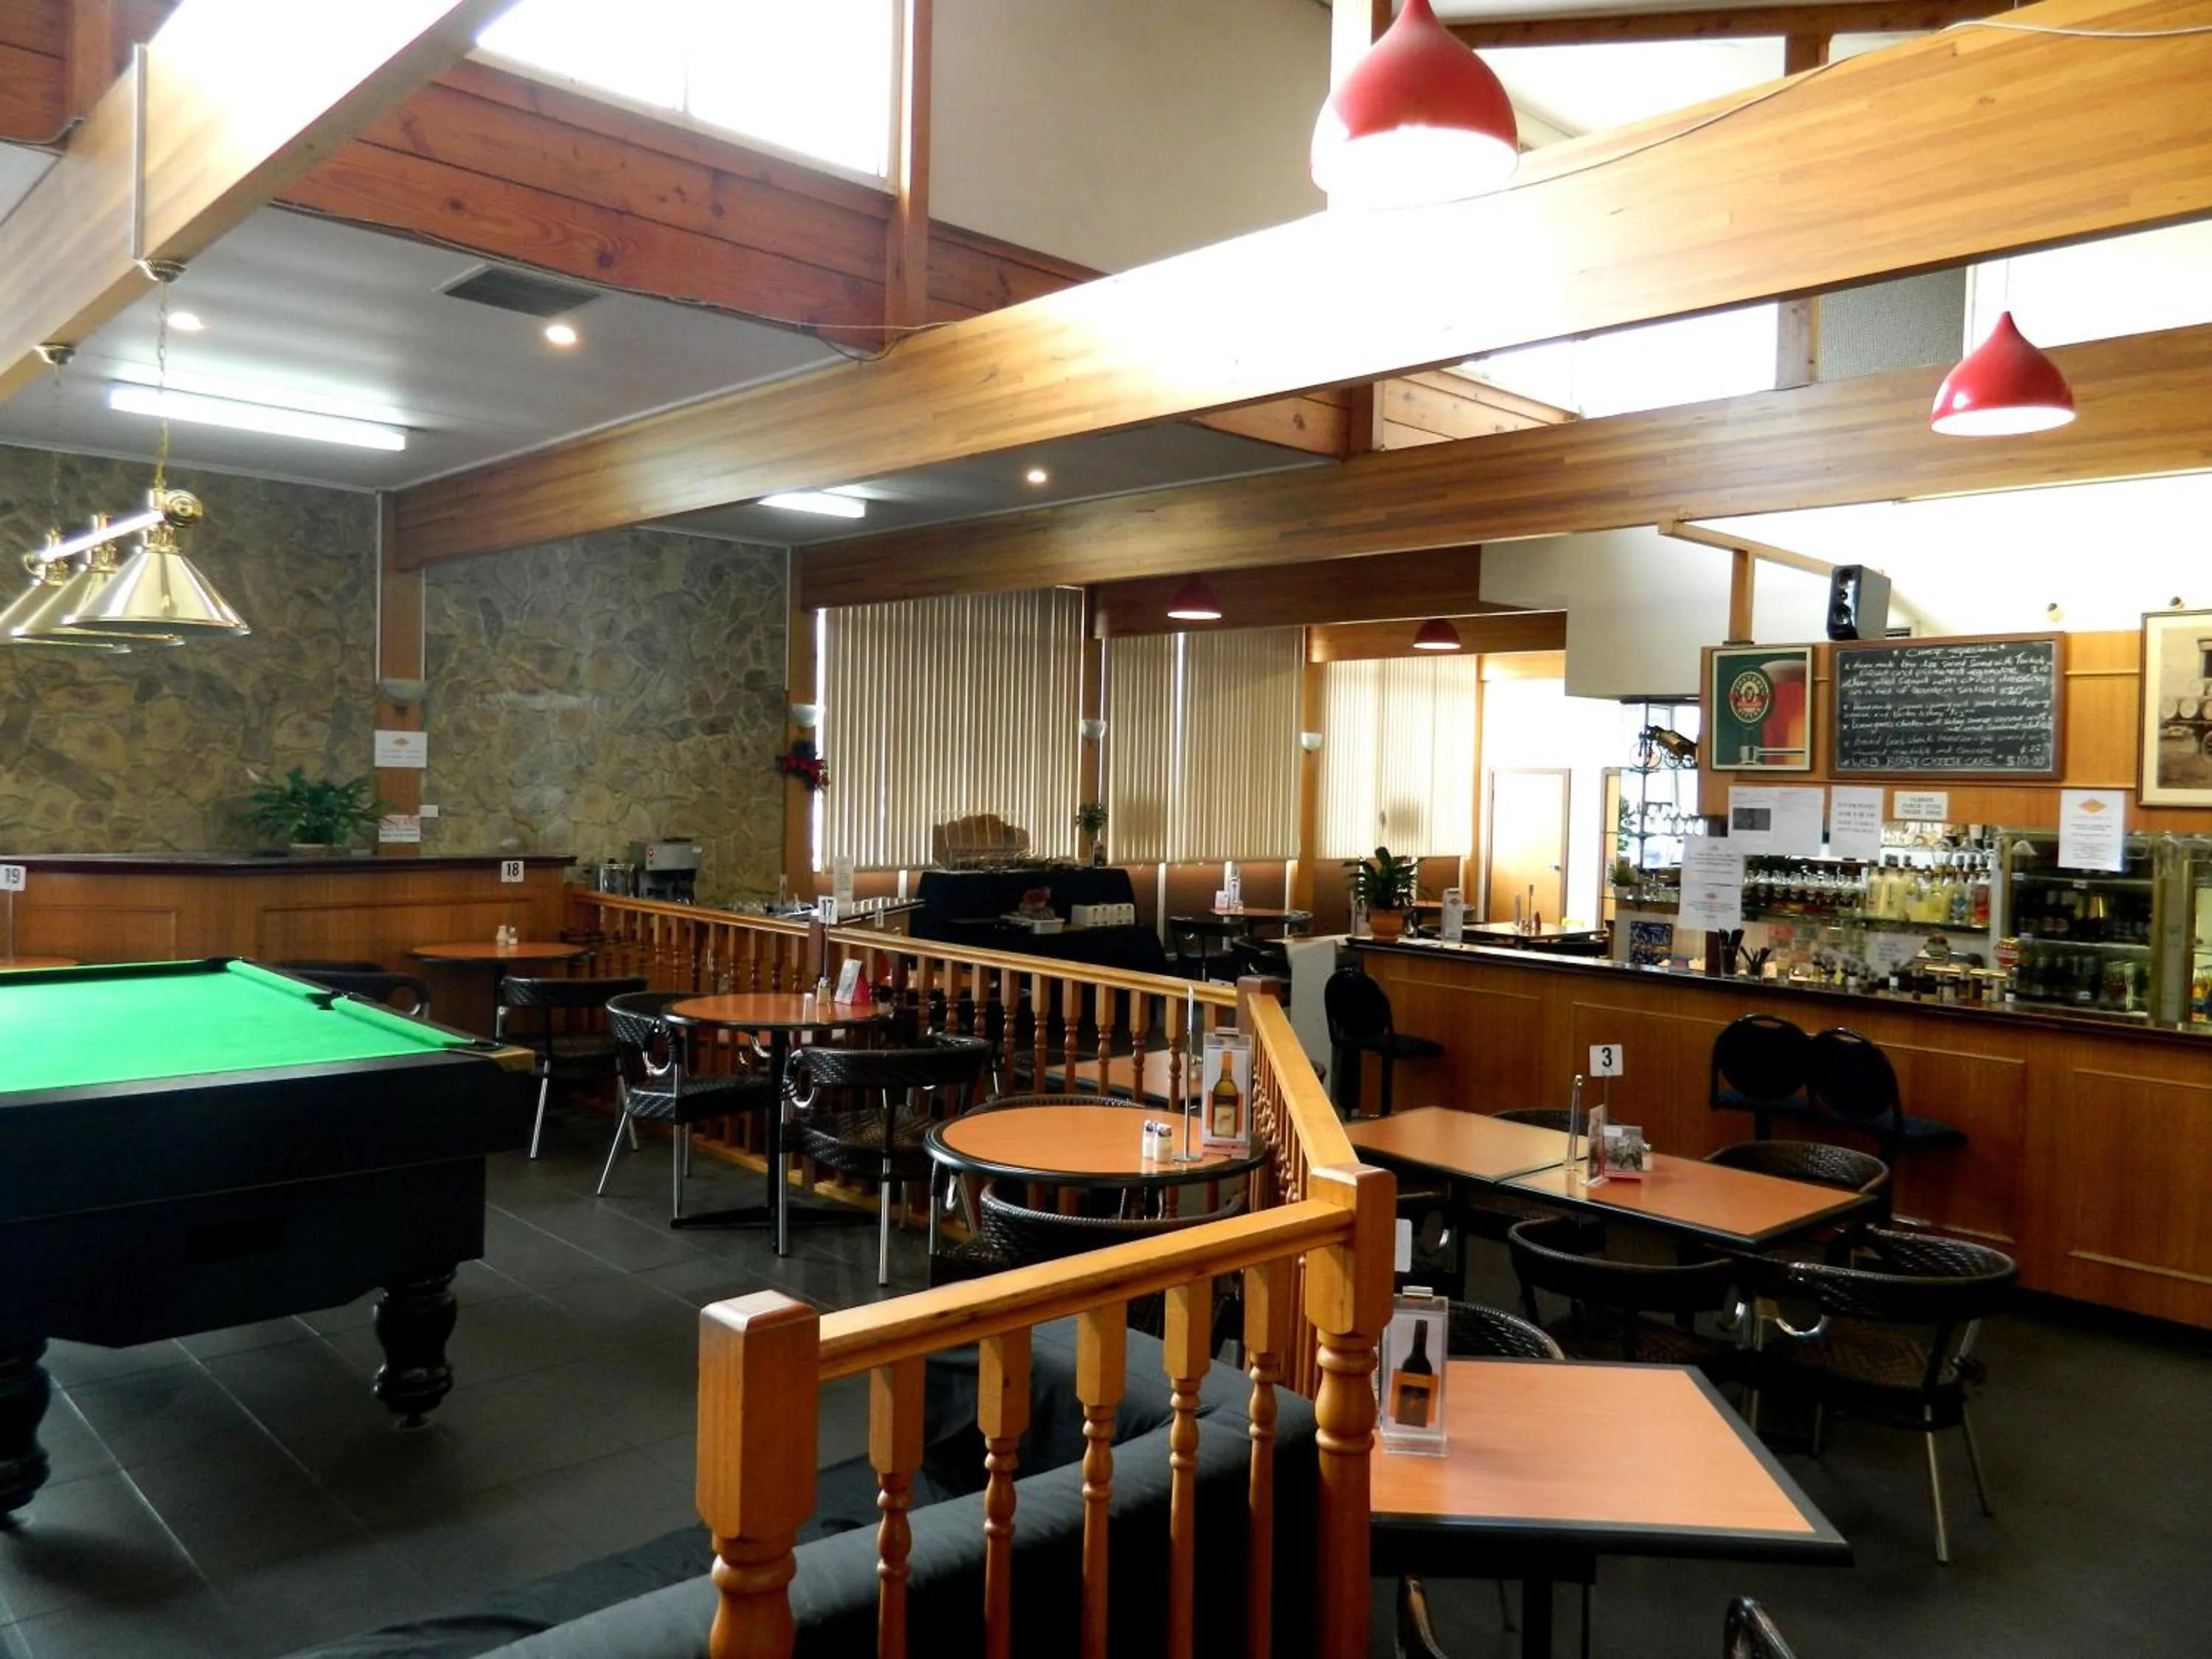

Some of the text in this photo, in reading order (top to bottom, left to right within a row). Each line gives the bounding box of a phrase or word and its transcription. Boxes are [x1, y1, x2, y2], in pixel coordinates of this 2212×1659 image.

[4, 866, 21, 884] 19
[507, 862, 520, 877] 18
[821, 898, 834, 917] 17
[1601, 1046, 1613, 1067] 3
